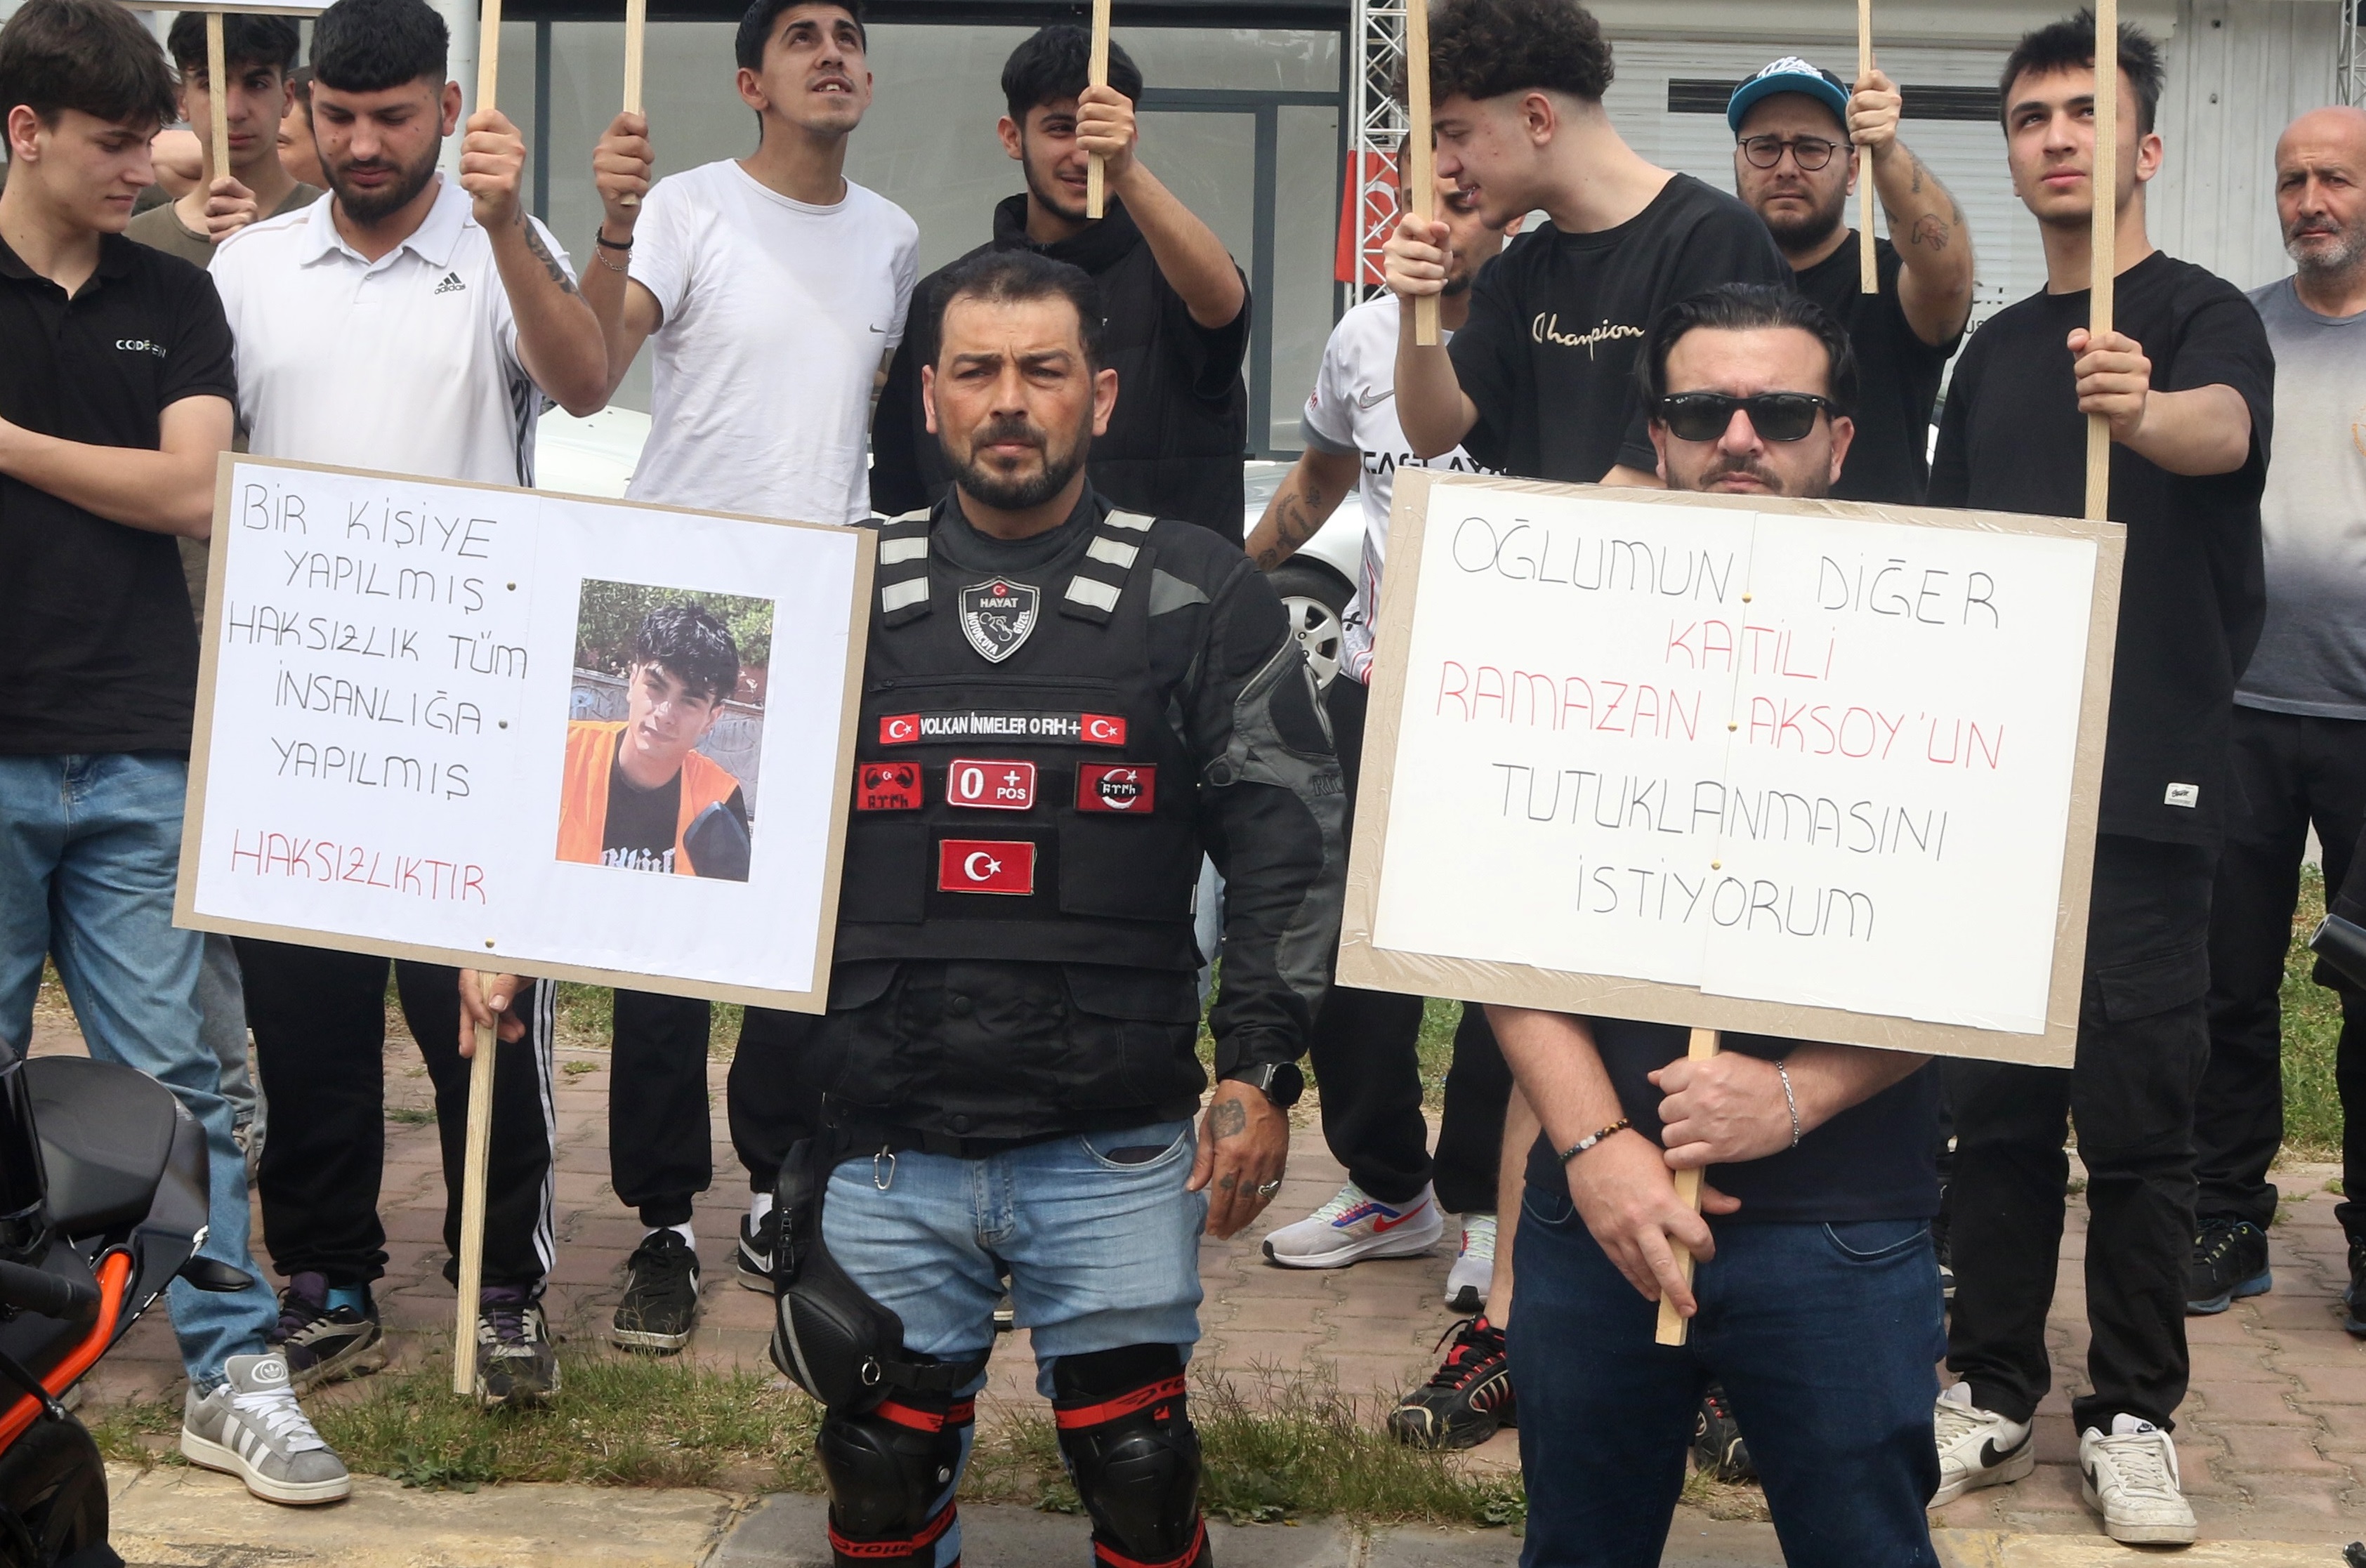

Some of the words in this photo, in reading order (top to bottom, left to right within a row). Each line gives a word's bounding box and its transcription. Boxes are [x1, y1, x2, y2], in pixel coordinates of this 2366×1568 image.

[434, 283, 466, 295] adidas
[1532, 312, 1646, 362] Champion
[243, 483, 307, 535] BİR
[347, 496, 497, 559] KİŞİYE
[284, 550, 484, 615] YAPILMIŞ
[979, 598, 1019, 608] HAYAT
[1452, 517, 1734, 604] OĞLUMUN
[1817, 551, 1999, 629] DİĞER
[228, 601, 419, 661] HAKSIZLIK
[447, 630, 527, 680] TÜM
[966, 611, 999, 654] MOTORCUYA
[1012, 610, 1031, 635] GÜZEL
[1665, 618, 1835, 681] KATİLİ
[275, 659, 481, 735] İNSANLIĞA
[920, 717, 968, 735] VOLKAN
[970, 711, 1027, 734] İNMELER
[1041, 718, 1082, 735] RH+
[1436, 660, 1702, 742] RAMAZAN
[1749, 695, 2004, 770] AKSOY'UN
[270, 737, 470, 801] YAPILMIŞ
[997, 786, 1026, 800] POS
[1492, 763, 1947, 862] TUTUKLANMASINI
[231, 829, 486, 905] HAKSIZLIKTIR
[1577, 854, 1874, 942] İSTİYORUM
